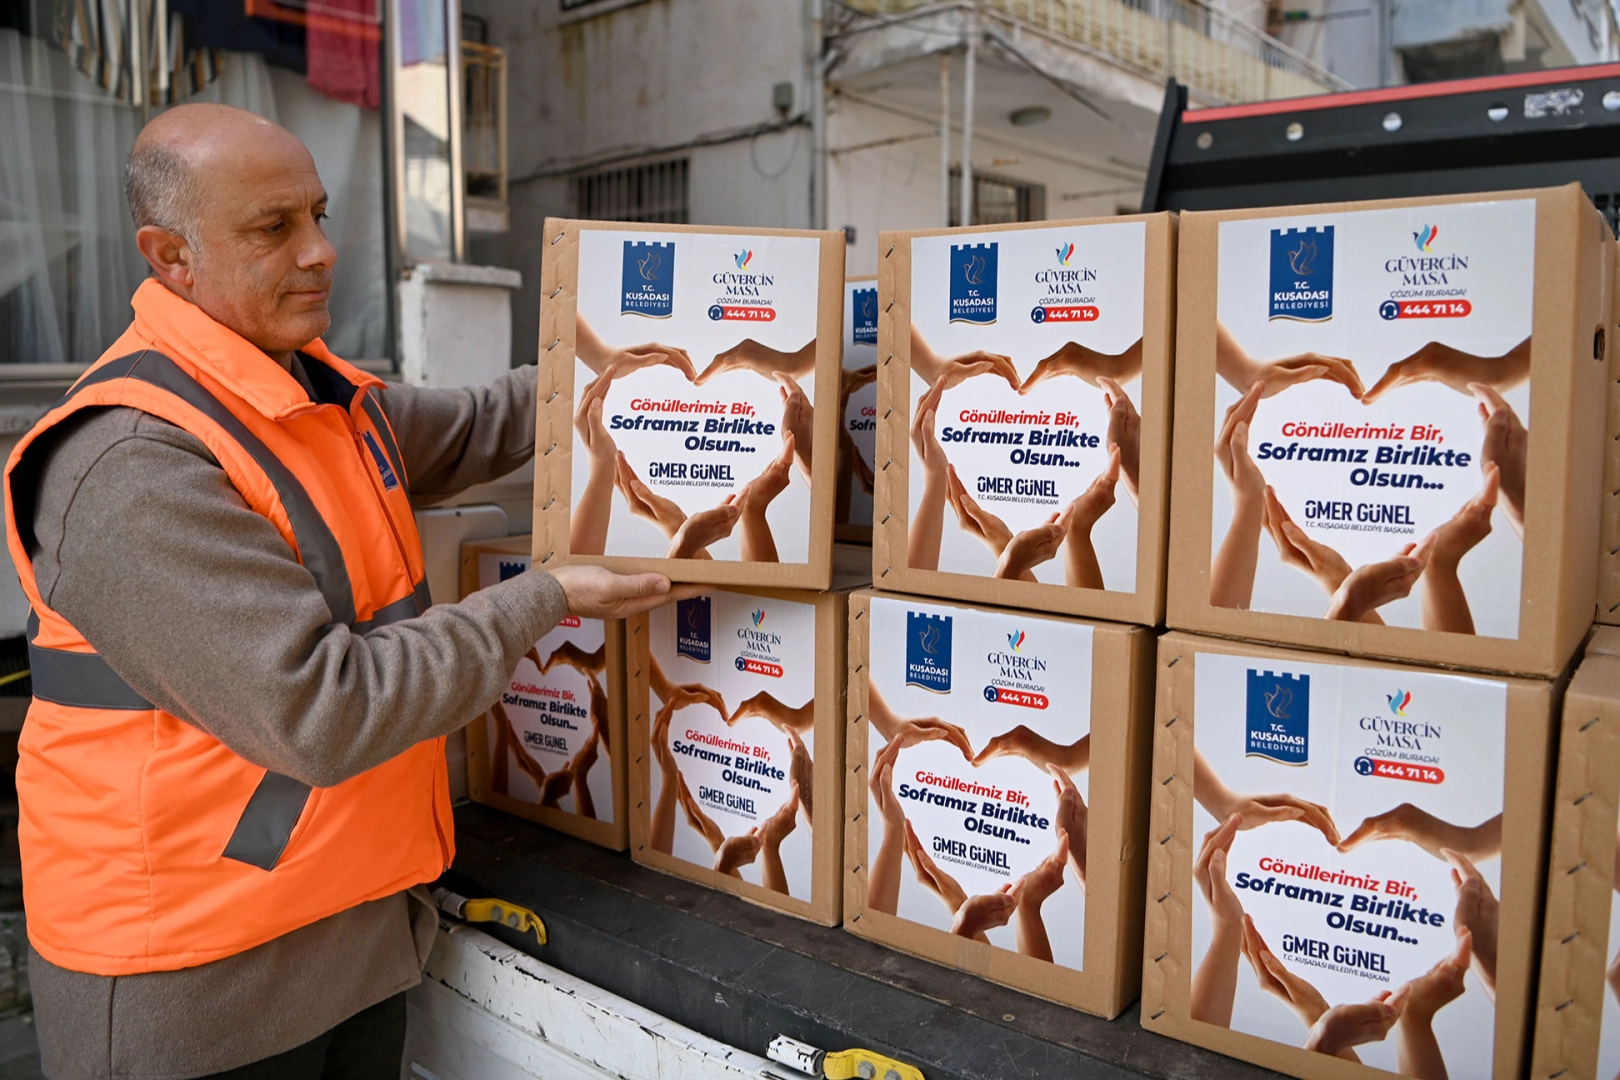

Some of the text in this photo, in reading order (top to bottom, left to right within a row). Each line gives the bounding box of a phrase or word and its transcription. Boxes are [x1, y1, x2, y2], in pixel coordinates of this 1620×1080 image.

[1385, 254, 1468, 272] GÜVERCİN
[713, 272, 773, 285] GÜVERCİN
[1035, 268, 1096, 283] GÜVERCİN
[1403, 273, 1448, 285] MASA
[726, 286, 759, 296] MASA
[1048, 283, 1081, 294] MASA
[1294, 281, 1309, 289] T.C.
[626, 293, 669, 301] KUŞADASI
[716, 297, 741, 305] ÇÖZÜM
[954, 298, 993, 306] KUŞADASI
[1039, 298, 1063, 306] ÇÖZÜM
[1274, 291, 1328, 301] KUŞADASI
[1390, 290, 1423, 299] ÇÖZÜM
[1274, 301, 1328, 309] BELEDİYESİ
[1404, 305, 1430, 314] 444
[1049, 310, 1068, 318] 444
[631, 399, 755, 417] Gönüllerimiz Bir,
[610, 415, 775, 435] Soframız Birlikte
[960, 410, 1079, 428] Gönüllerimiz Bir,
[941, 427, 1100, 448] Soframız Birlikte
[1282, 422, 1443, 444] Gönüllerimiz Bir,
[685, 436, 755, 453] Olsun...
[1010, 449, 1080, 467] Olsun...
[1257, 443, 1471, 467] Soframız Birlikte
[690, 464, 734, 480] GÜNEL
[1350, 468, 1444, 489] Olsun...
[1016, 479, 1059, 497] GÜNEL
[1357, 503, 1414, 525] GÜNEL
[738, 628, 781, 644] GÜVERCİN
[747, 641, 770, 653] MASA
[748, 663, 762, 671] 444
[988, 652, 1046, 671] GÜVERCİN
[910, 664, 948, 676] KUŞADASI
[910, 672, 948, 683] BELEDİYESİ
[1000, 667, 1032, 681] MASA
[991, 679, 1045, 692] ÇÖZÜM BURADA!
[1001, 693, 1019, 702] 444
[1270, 724, 1285, 732] T.C.
[1360, 716, 1440, 738] GÜVERCİN
[686, 729, 770, 761] Gönüllerimiz Bir,
[1251, 731, 1304, 745] KUŞADASI
[1377, 734, 1421, 750] MASA
[1251, 741, 1303, 753] BELEDİYESİ
[673, 740, 785, 780] Soframız Birlikte
[1364, 748, 1440, 764] ÇÖZÜM BURADA!
[1378, 765, 1404, 776] 444
[722, 769, 771, 793] Olsun...
[916, 771, 1029, 808] Gönüllerimiz Bir,
[726, 794, 756, 814] GÜNEL
[899, 784, 1049, 829] Soframız Birlikte
[964, 817, 1030, 845] Olsun...
[970, 845, 1010, 869] GÜNEL
[1259, 858, 1417, 901] Gönüllerimiz Bir,
[1235, 873, 1444, 927] Soframız Birlikte
[1327, 912, 1418, 945] Olsun...
[1334, 945, 1390, 974] GÜNEL
